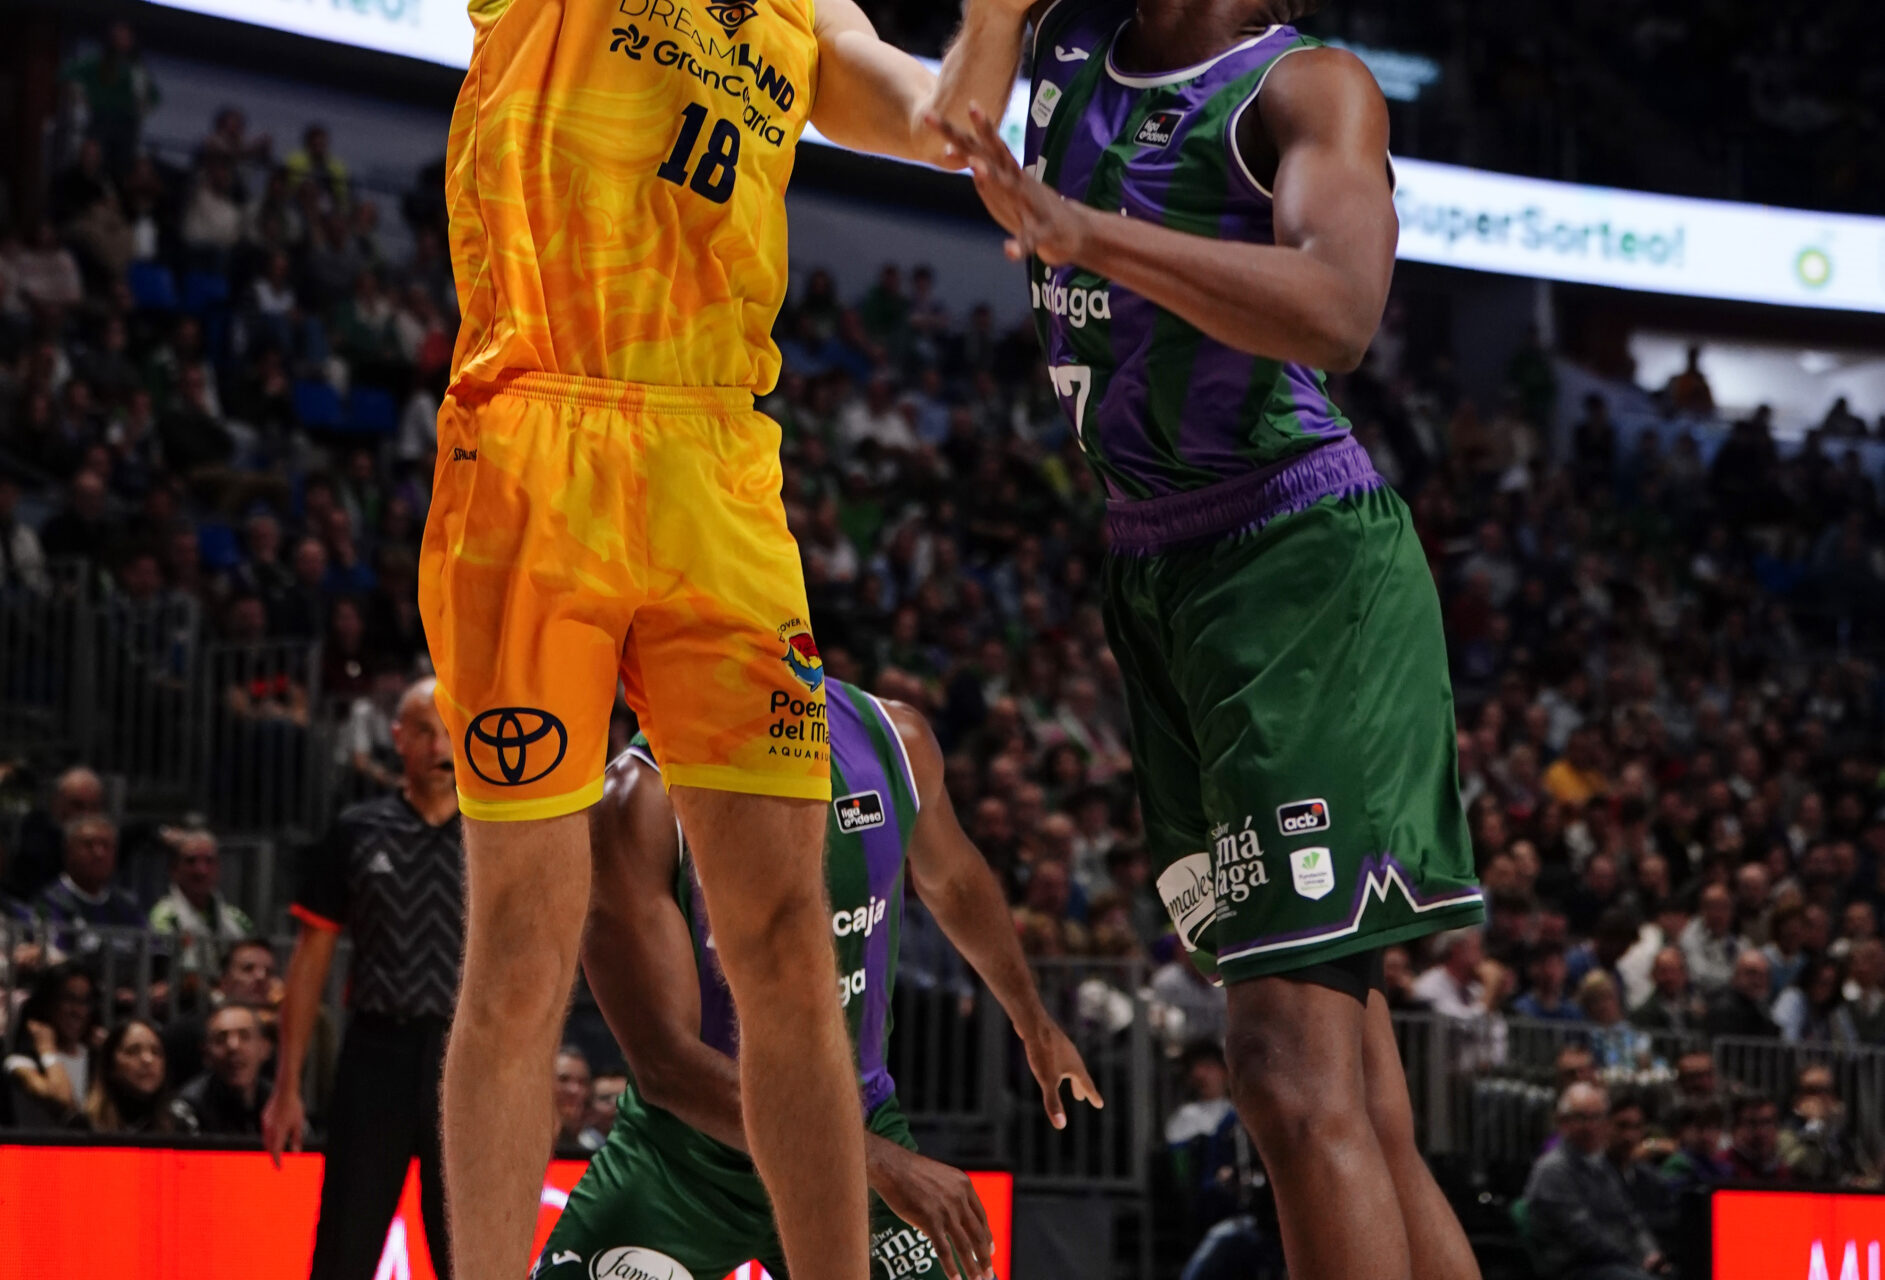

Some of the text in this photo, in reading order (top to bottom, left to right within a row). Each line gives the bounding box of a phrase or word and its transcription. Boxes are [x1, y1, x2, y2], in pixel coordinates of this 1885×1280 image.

[656, 102, 741, 204] 18
[769, 718, 804, 740] del
[841, 807, 860, 819] liga
[844, 812, 881, 828] endesa
[1284, 812, 1318, 830] acb
[1215, 814, 1265, 869] má
[1214, 859, 1270, 903] laga
